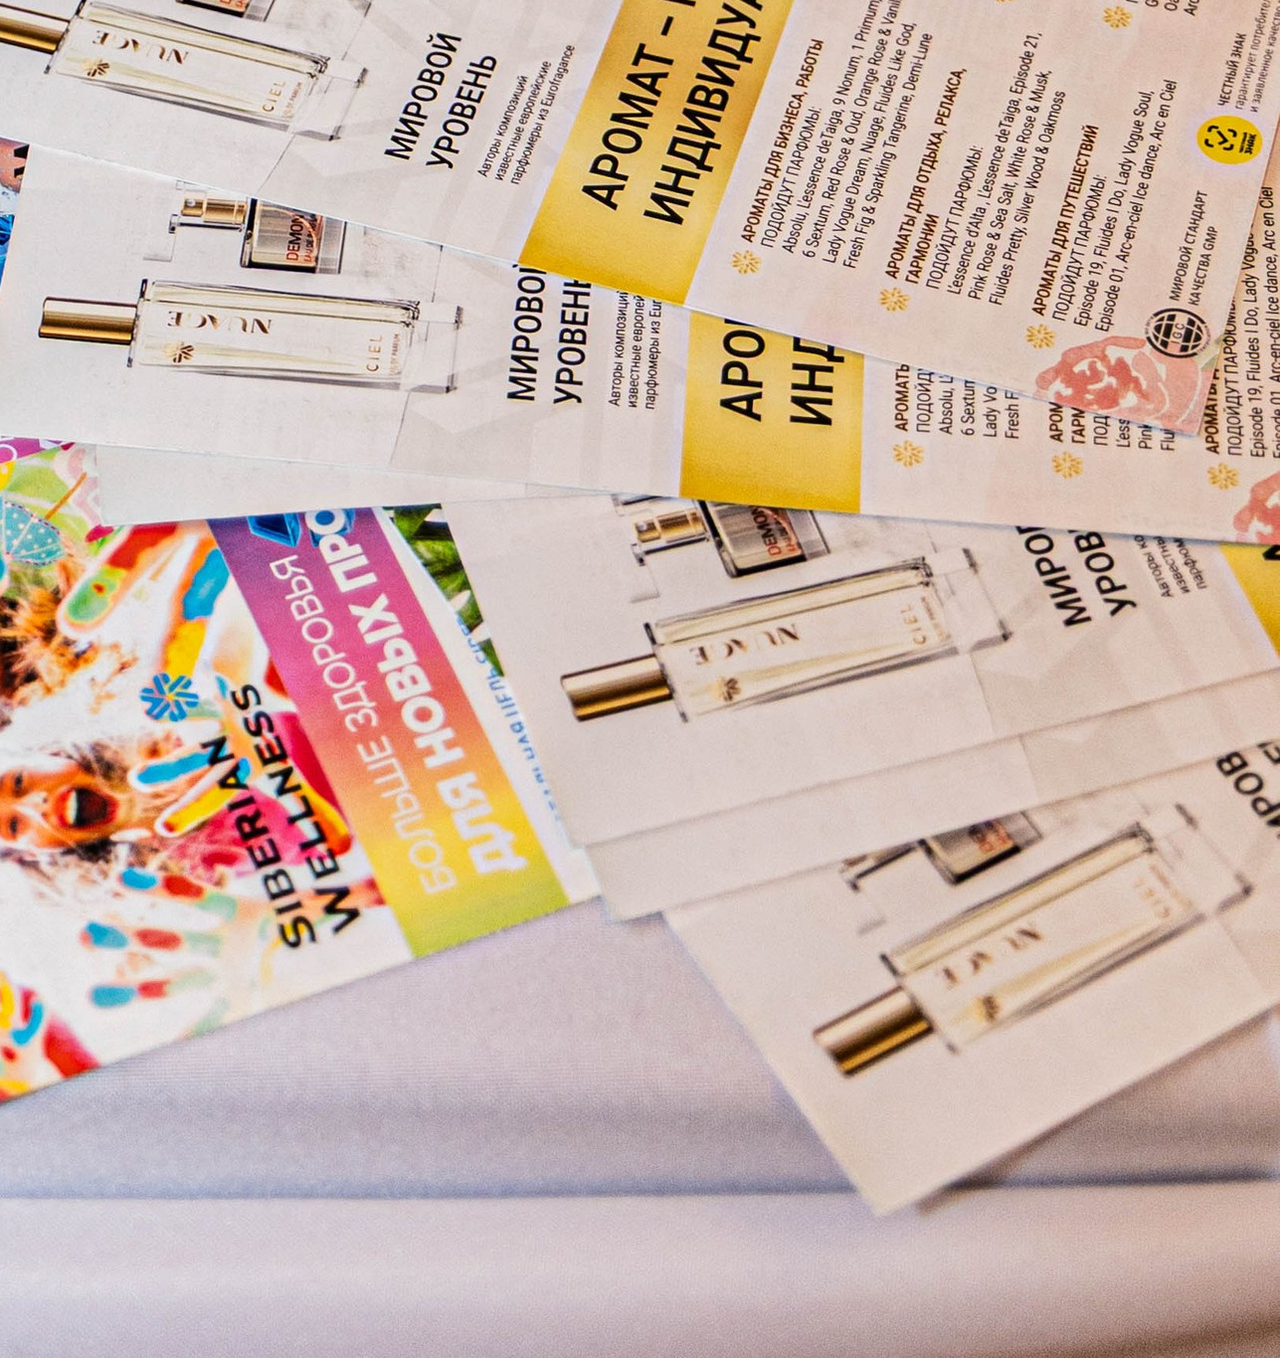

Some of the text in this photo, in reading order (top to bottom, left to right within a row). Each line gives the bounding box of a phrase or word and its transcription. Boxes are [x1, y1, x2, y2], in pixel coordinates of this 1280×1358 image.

[92, 30, 189, 65] NUAGE
[853, 67, 879, 107] Orange
[866, 38, 888, 66] Rose
[901, 33, 932, 91] Demi-Lune
[1217, 32, 1246, 106] ЧЕСТНЫЙ ЗНАК
[382, 30, 463, 161] МИРОВОЙ
[423, 53, 498, 170] УРОВЕНЬ
[476, 75, 527, 177] Авторы композиций
[494, 60, 551, 181] известные европейские
[510, 44, 575, 185] парфюмеры из Eurofragance
[580, 41, 675, 211] АРОМАТ
[660, 15, 674, 36] –
[843, 110, 866, 134] Oud,
[881, 93, 915, 147] Tangerine,
[740, 38, 823, 243] АРОМАТЫ ДЛЯ БИЗНЕСА, РАБОТЫ
[760, 106, 821, 248] ПОДОЙДУТ ПАРФЮМЫ:
[781, 211, 809, 254] Absolu,
[835, 54, 863, 96] Nonum,
[829, 146, 851, 176] Rose
[864, 150, 896, 203] Sparkling
[884, 68, 967, 279] АРОМАТЫ ДЛЯ ОТДЫХА, РЕЛАКСА,
[804, 203, 834, 248] Sextum,
[820, 176, 841, 200] Red
[853, 215, 875, 234] Fig
[1031, 122, 1100, 316] АРОМАТЫ ДЛЯ ПУТЕШЕСТВИЙ
[1094, 78, 1177, 332] Episode 01, Arc-en-ciel Ice dance, Arc en Ciel
[842, 236, 865, 269] Fresh
[904, 213, 939, 284] ГАРМОНИИ
[1168, 189, 1207, 301] МИРОВОЙ СТАНДАРТ
[1187, 225, 1218, 306] КАЧЕСТВА GMP
[167, 310, 273, 335] NUAGE
[632, 294, 645, 342] европей
[1241, 272, 1260, 303] Lady
[1242, 306, 1260, 326] Do,
[553, 279, 592, 404] УРОВЕН
[644, 298, 662, 409] парфюмеры из Eur
[719, 318, 766, 422] АРО
[1244, 336, 1261, 381] Fluides
[1246, 384, 1263, 402] 19,
[1248, 406, 1267, 457] Episode
[305, 508, 379, 594] ПРО
[1015, 525, 1092, 627] МИРО
[1073, 530, 1138, 617] УРОВ
[1143, 551, 1173, 598] Авторы
[1153, 536, 1191, 594] известны
[1173, 537, 1208, 590] парфюм
[348, 593, 466, 770] НОВЫХ
[270, 553, 458, 896] БОЛЬШЕ ЗДОРОВЬЯ
[202, 737, 317, 950] SIBERIAN
[228, 684, 362, 935] WELLNESS
[437, 771, 529, 875] ДЛЯ
